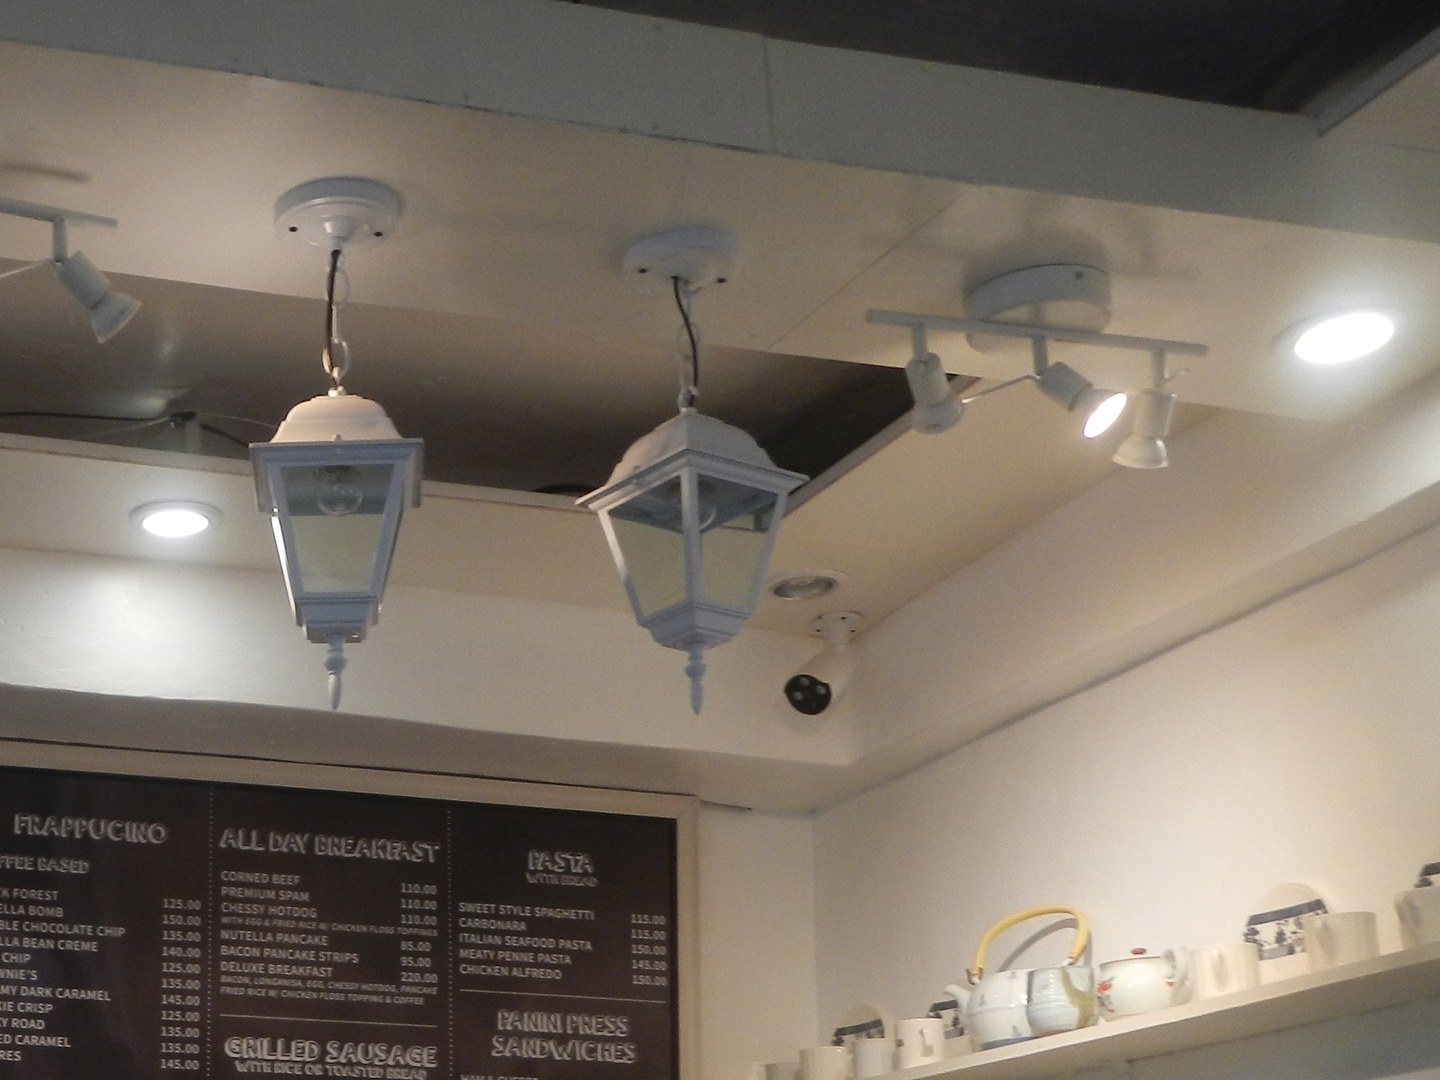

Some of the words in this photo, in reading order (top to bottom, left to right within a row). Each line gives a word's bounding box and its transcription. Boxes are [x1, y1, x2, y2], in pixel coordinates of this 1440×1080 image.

[14, 813, 168, 844] FRAPPUCINO
[219, 828, 265, 851] ALL
[269, 831, 310, 854] DAY
[37, 856, 90, 874] BASED
[13, 888, 59, 900] FOREST
[28, 905, 64, 917] BOMB
[23, 921, 93, 935] CHOCOLATE
[97, 926, 126, 937] CHIP
[23, 937, 54, 949] BEAN
[58, 939, 98, 952] CREME
[221, 930, 273, 943] NUTELLA
[276, 933, 328, 945] PANCAKE
[2, 953, 31, 963] CHIP
[460, 964, 509, 976] CHICKEN
[512, 967, 562, 979] ALFREDO
[21, 986, 53, 998] DARK
[56, 988, 111, 1001] CARAMEL
[17, 1002, 53, 1014] CRISP
[12, 1018, 45, 1030] ROAD
[566, 1013, 630, 1037] PRESS
[15, 1035, 71, 1047] CARAMEL
[224, 1036, 321, 1062] GRILLED
[325, 1040, 438, 1068] SAUSAGE
